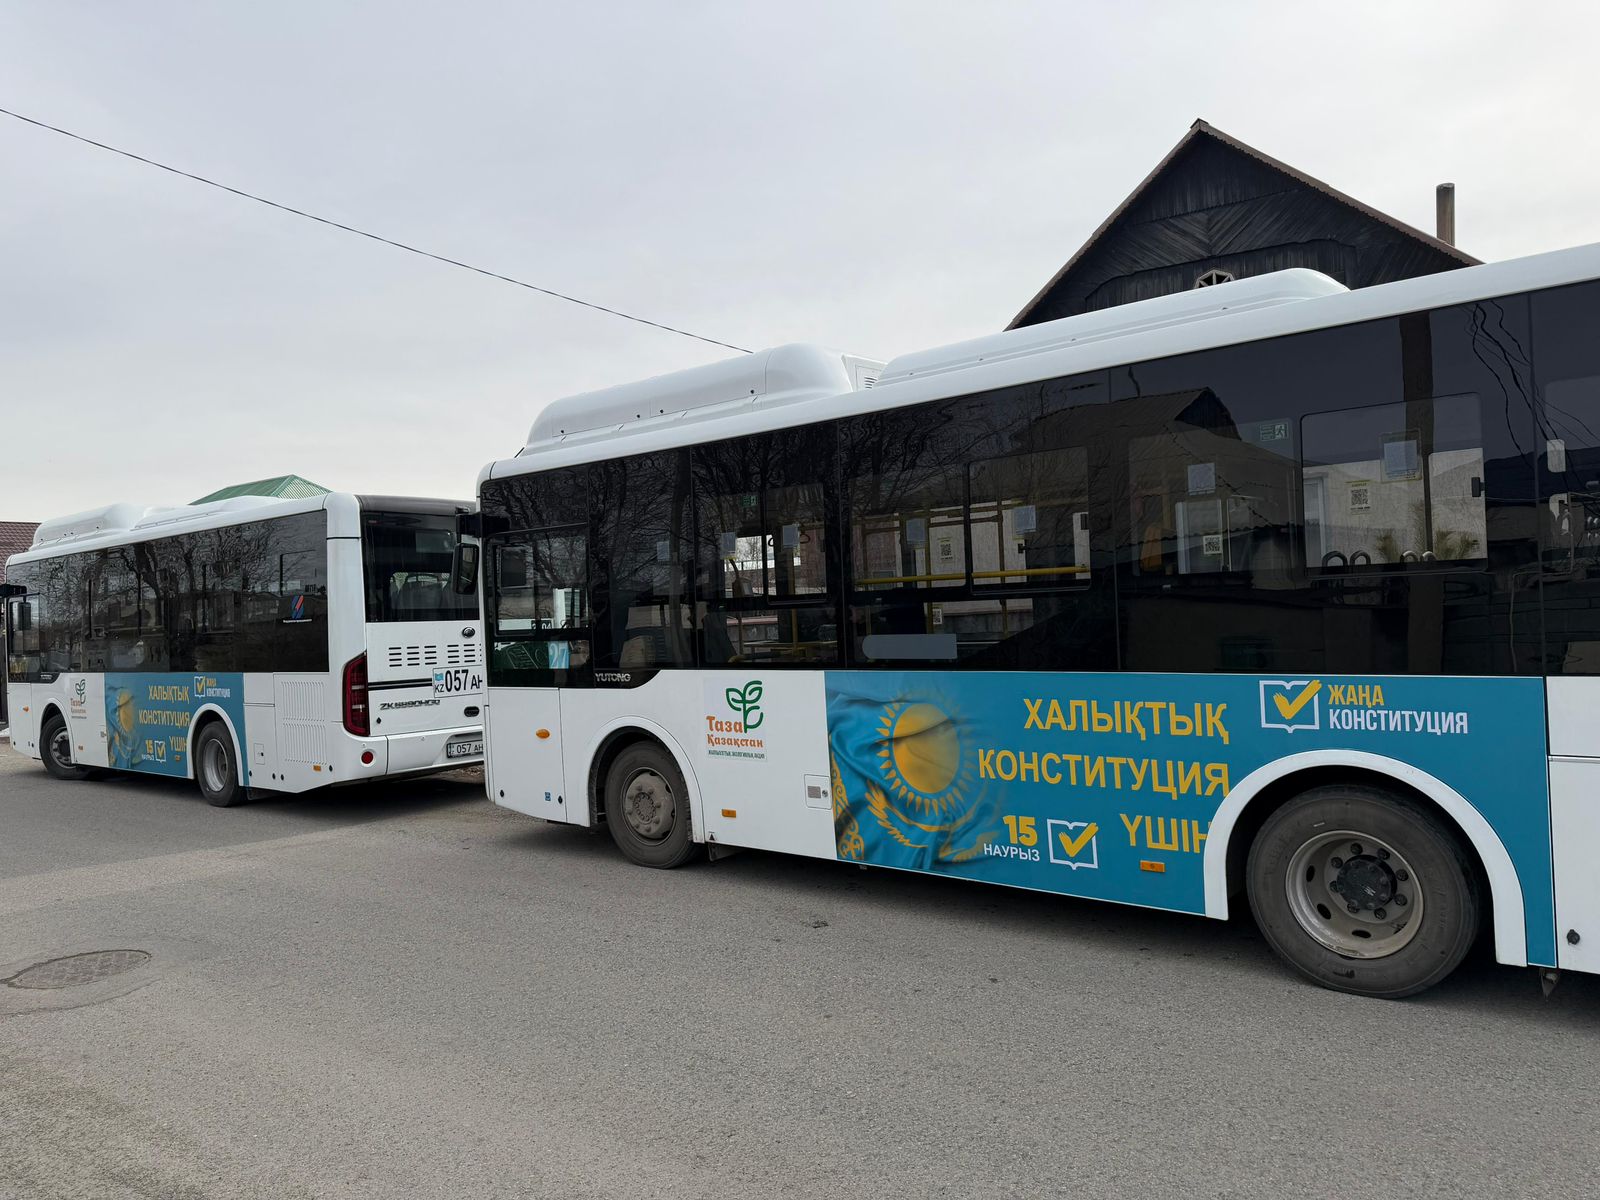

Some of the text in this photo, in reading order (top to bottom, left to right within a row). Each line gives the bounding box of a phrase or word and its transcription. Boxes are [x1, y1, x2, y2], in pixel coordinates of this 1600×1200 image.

[444, 669, 469, 692] 057
[595, 672, 631, 682] YUTONG
[148, 685, 190, 704] ХАЛЫҚТЫҚ
[434, 684, 445, 693] KZ
[1327, 684, 1385, 708] ЖАҢА
[139, 709, 191, 729] КОНСТИТУЦИЯ
[706, 715, 743, 733] Таза
[1023, 698, 1230, 745] ХАЛЫҚТЫҚ
[1329, 708, 1469, 735] КОНСТИТУЦИЯ
[456, 743, 472, 754] 057
[707, 733, 764, 748] Қазақстан
[978, 748, 1230, 800] КОНСТИТУЦИЯ
[1003, 815, 1038, 847] 15
[983, 843, 1041, 862] НАУРЫЗ
